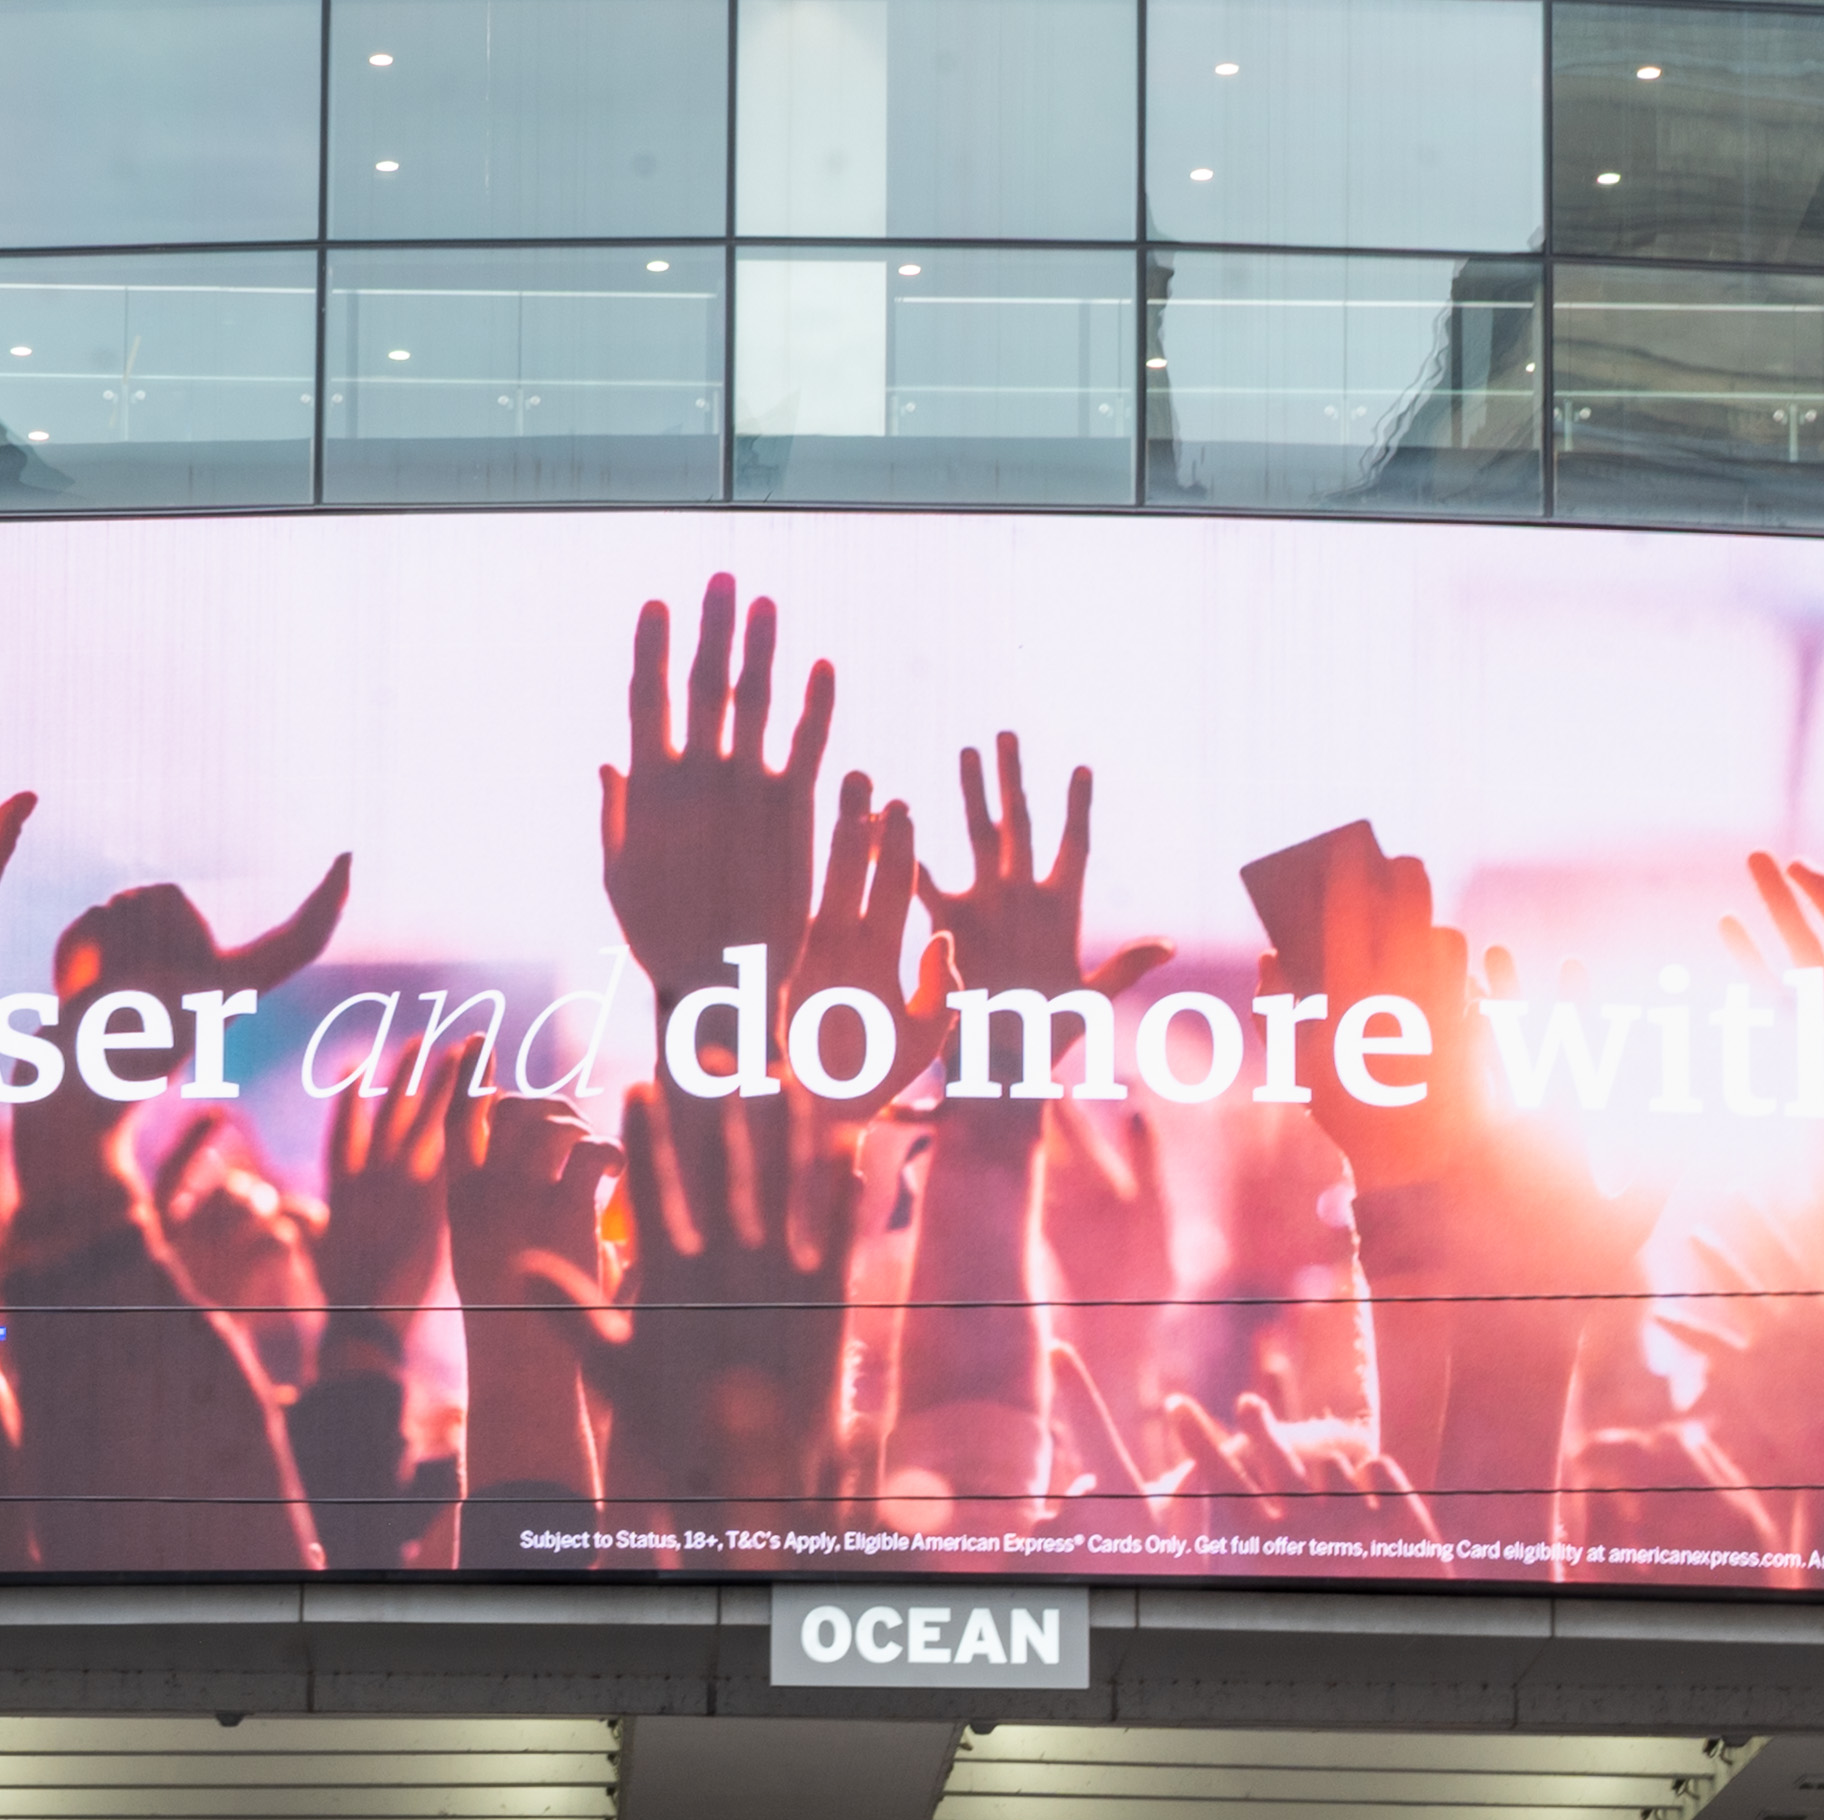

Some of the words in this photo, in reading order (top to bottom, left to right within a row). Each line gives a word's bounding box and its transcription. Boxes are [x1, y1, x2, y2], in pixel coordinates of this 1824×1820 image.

[302, 944, 630, 1099] and
[665, 943, 896, 1100] do
[945, 982, 1433, 1105] more
[520, 1530, 588, 1552] Subject
[593, 1532, 613, 1549] to
[616, 1530, 681, 1552] Status,
[844, 1531, 909, 1555] Eligible
[911, 1533, 1000, 1553] American
[1088, 1534, 1142, 1554] Cards
[1145, 1534, 1192, 1558] Only.
[1195, 1536, 1228, 1555] Get
[1231, 1535, 1259, 1555] full
[1263, 1536, 1306, 1557] offer
[1309, 1538, 1369, 1559] terms,
[1371, 1539, 1454, 1563] including
[1456, 1540, 1500, 1560] Card
[1504, 1542, 1582, 1565] eligibility
[1586, 1546, 1606, 1563] at
[801, 1604, 1060, 1664] OCEAN
